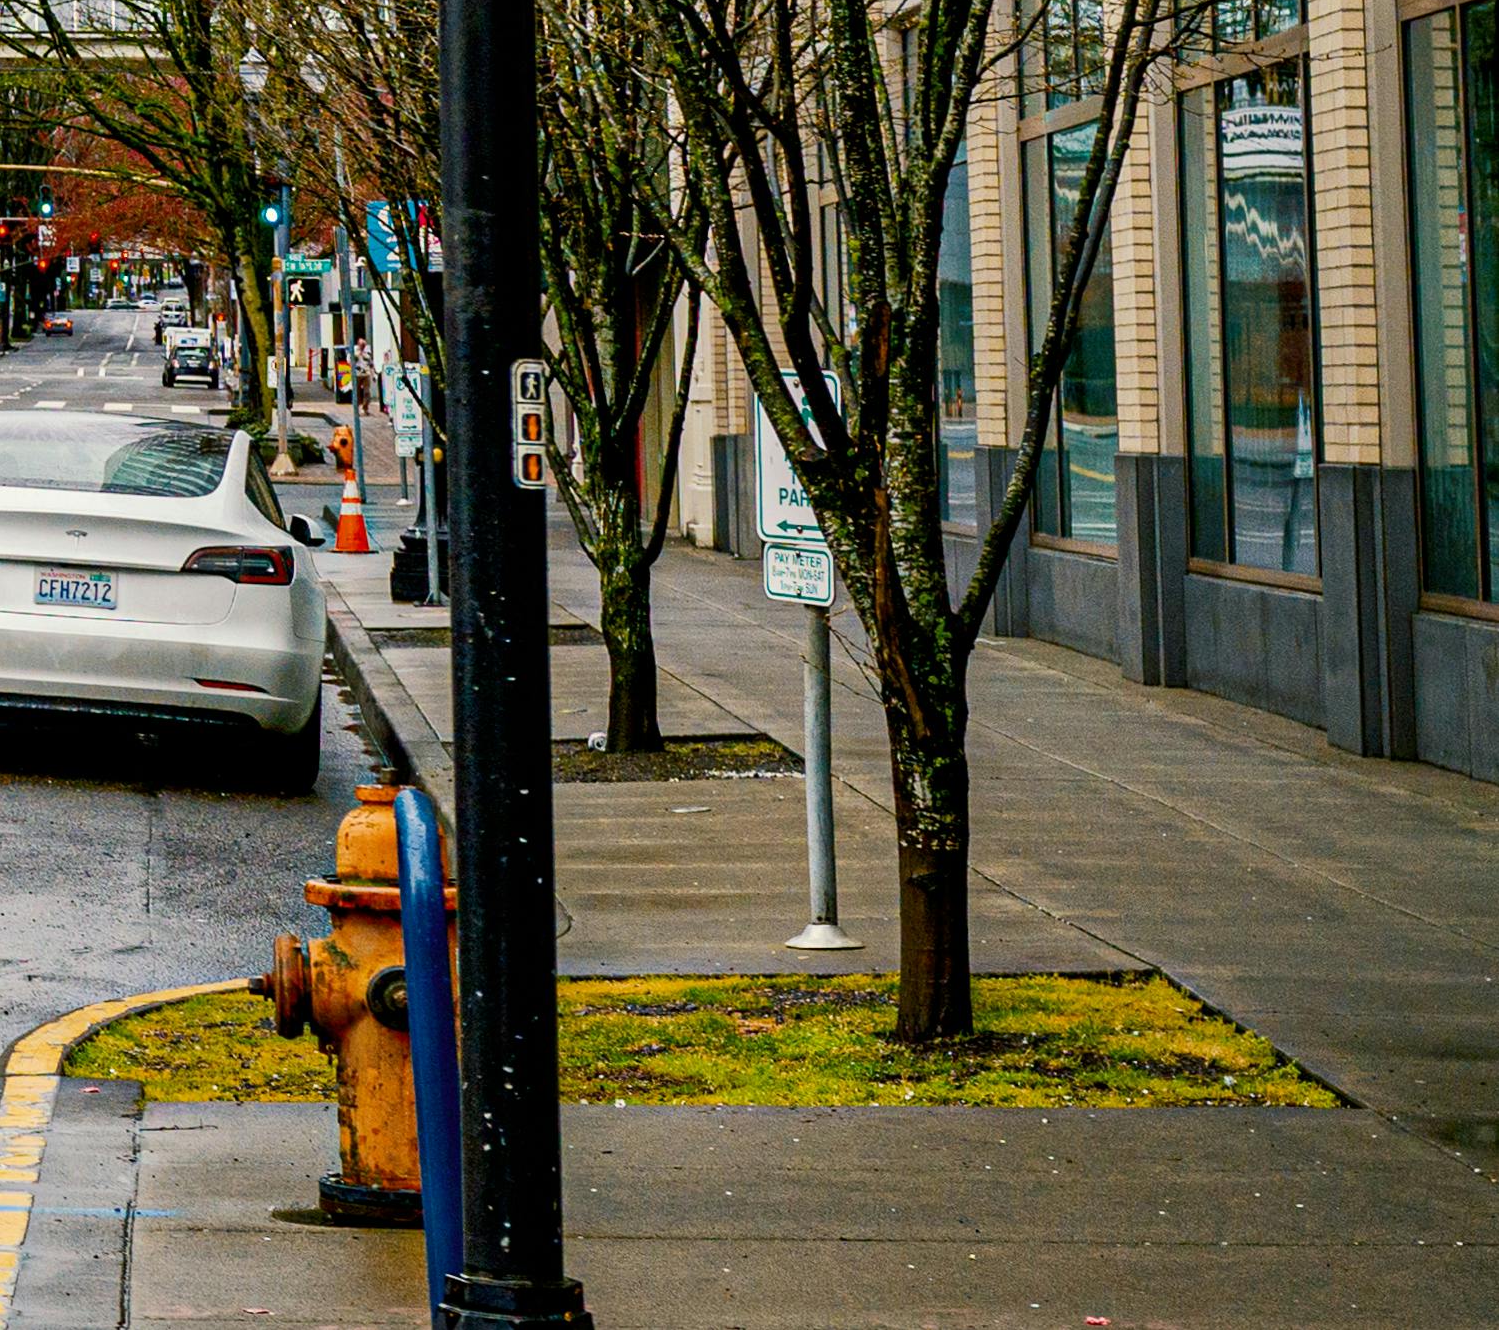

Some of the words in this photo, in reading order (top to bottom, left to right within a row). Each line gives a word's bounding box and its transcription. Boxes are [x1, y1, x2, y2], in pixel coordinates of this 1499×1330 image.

[778, 487, 810, 507] PAR
[774, 552, 789, 565] PAY
[792, 553, 822, 568] METER
[40, 571, 86, 580] WASHINGTON
[38, 579, 112, 603] CFH7212
